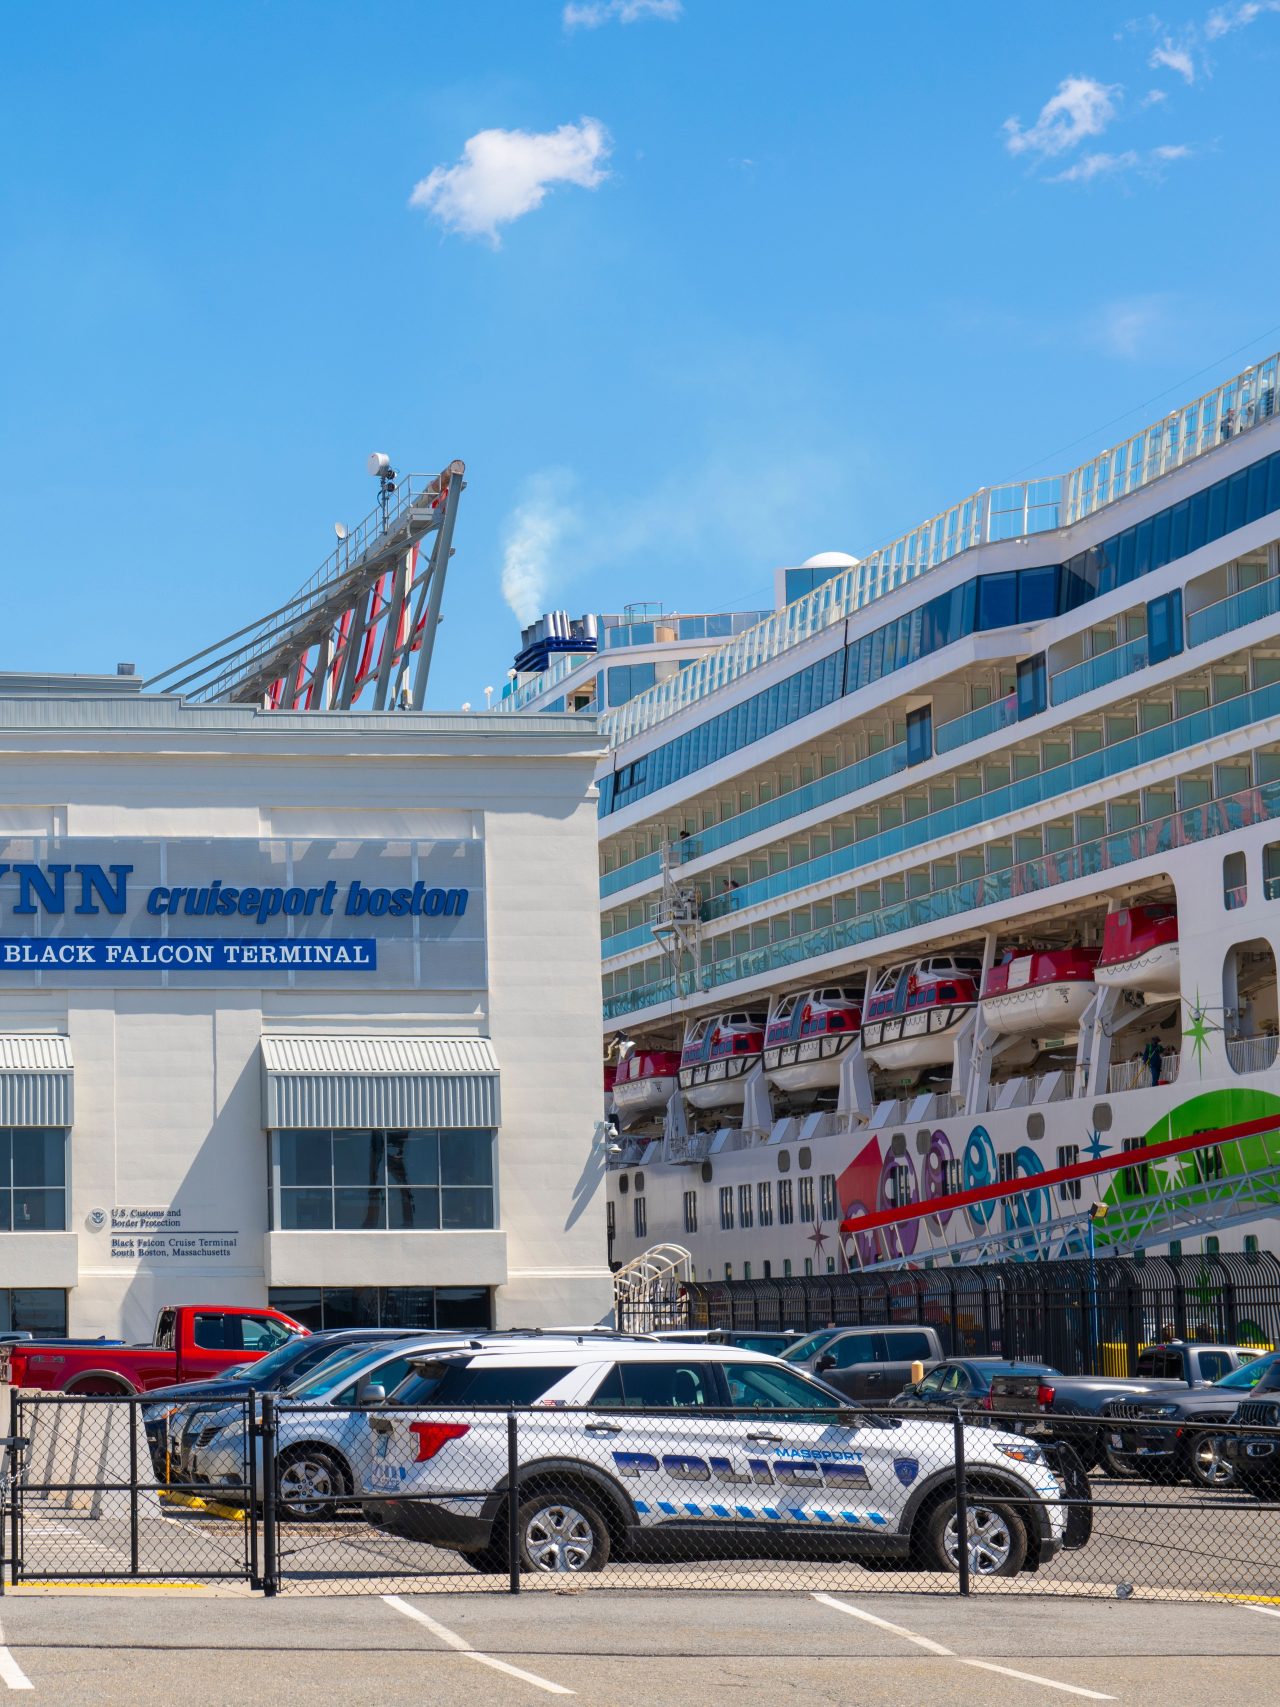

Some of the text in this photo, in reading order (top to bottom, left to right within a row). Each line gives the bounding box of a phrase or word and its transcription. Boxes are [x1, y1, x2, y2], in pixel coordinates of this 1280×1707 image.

[146, 880, 337, 924] cruiseport
[344, 881, 469, 917] boston
[3, 944, 93, 963] BLACK
[105, 944, 215, 964] FALCON
[223, 945, 370, 964] TERMINAL
[131, 1209, 165, 1217] Customs
[166, 1209, 182, 1217] and
[111, 1219, 181, 1228] Border Protection
[111, 1238, 237, 1247] Black Falcon Cruise Terminal
[111, 1249, 231, 1258] South Boston, Massachusetts
[774, 1447, 863, 1462] MASSPORT
[611, 1450, 873, 1490] POLICE
